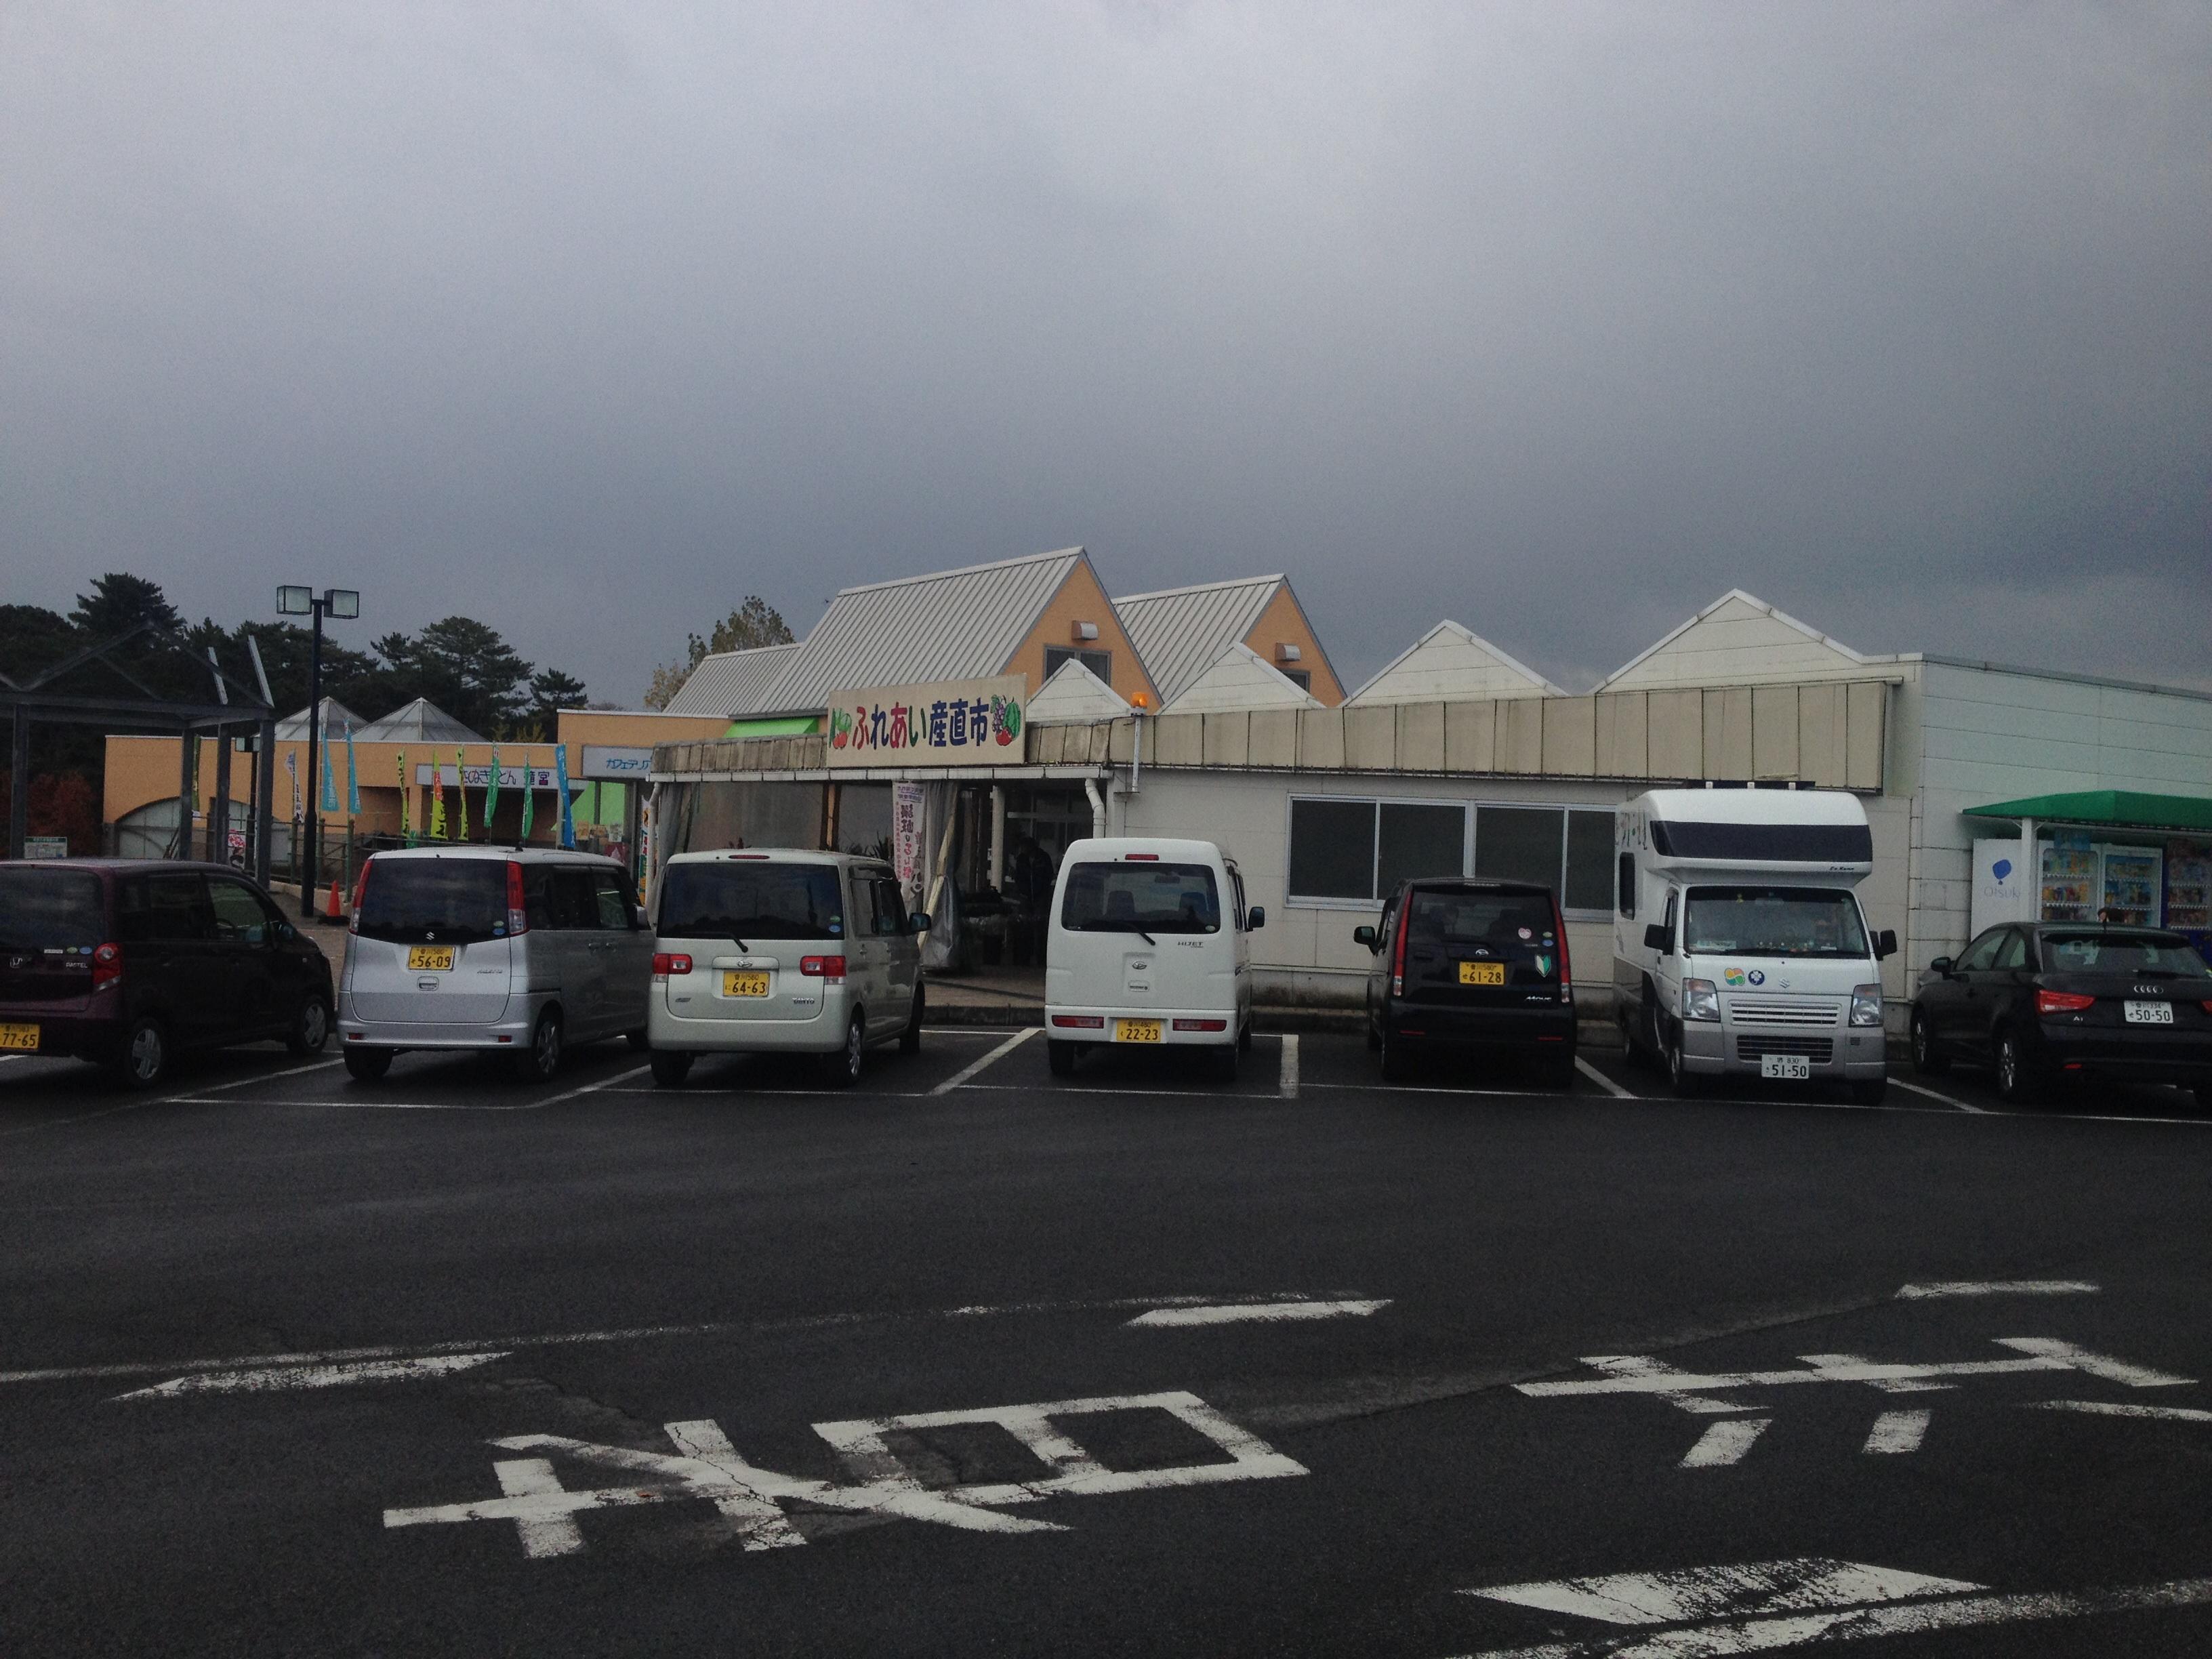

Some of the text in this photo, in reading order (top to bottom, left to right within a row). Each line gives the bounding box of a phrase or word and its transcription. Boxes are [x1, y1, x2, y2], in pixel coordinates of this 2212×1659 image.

[852, 697, 989, 750] ふれあい産直市
[417, 956, 451, 968] 56-09
[1469, 971, 1502, 983] 61-28
[732, 981, 766, 994] 64-63
[2135, 1009, 2171, 1021] 50-50
[3, 1033, 37, 1047] 77-65
[1126, 1028, 1159, 1040] 22-23
[1771, 1064, 1807, 1077] 51-50
